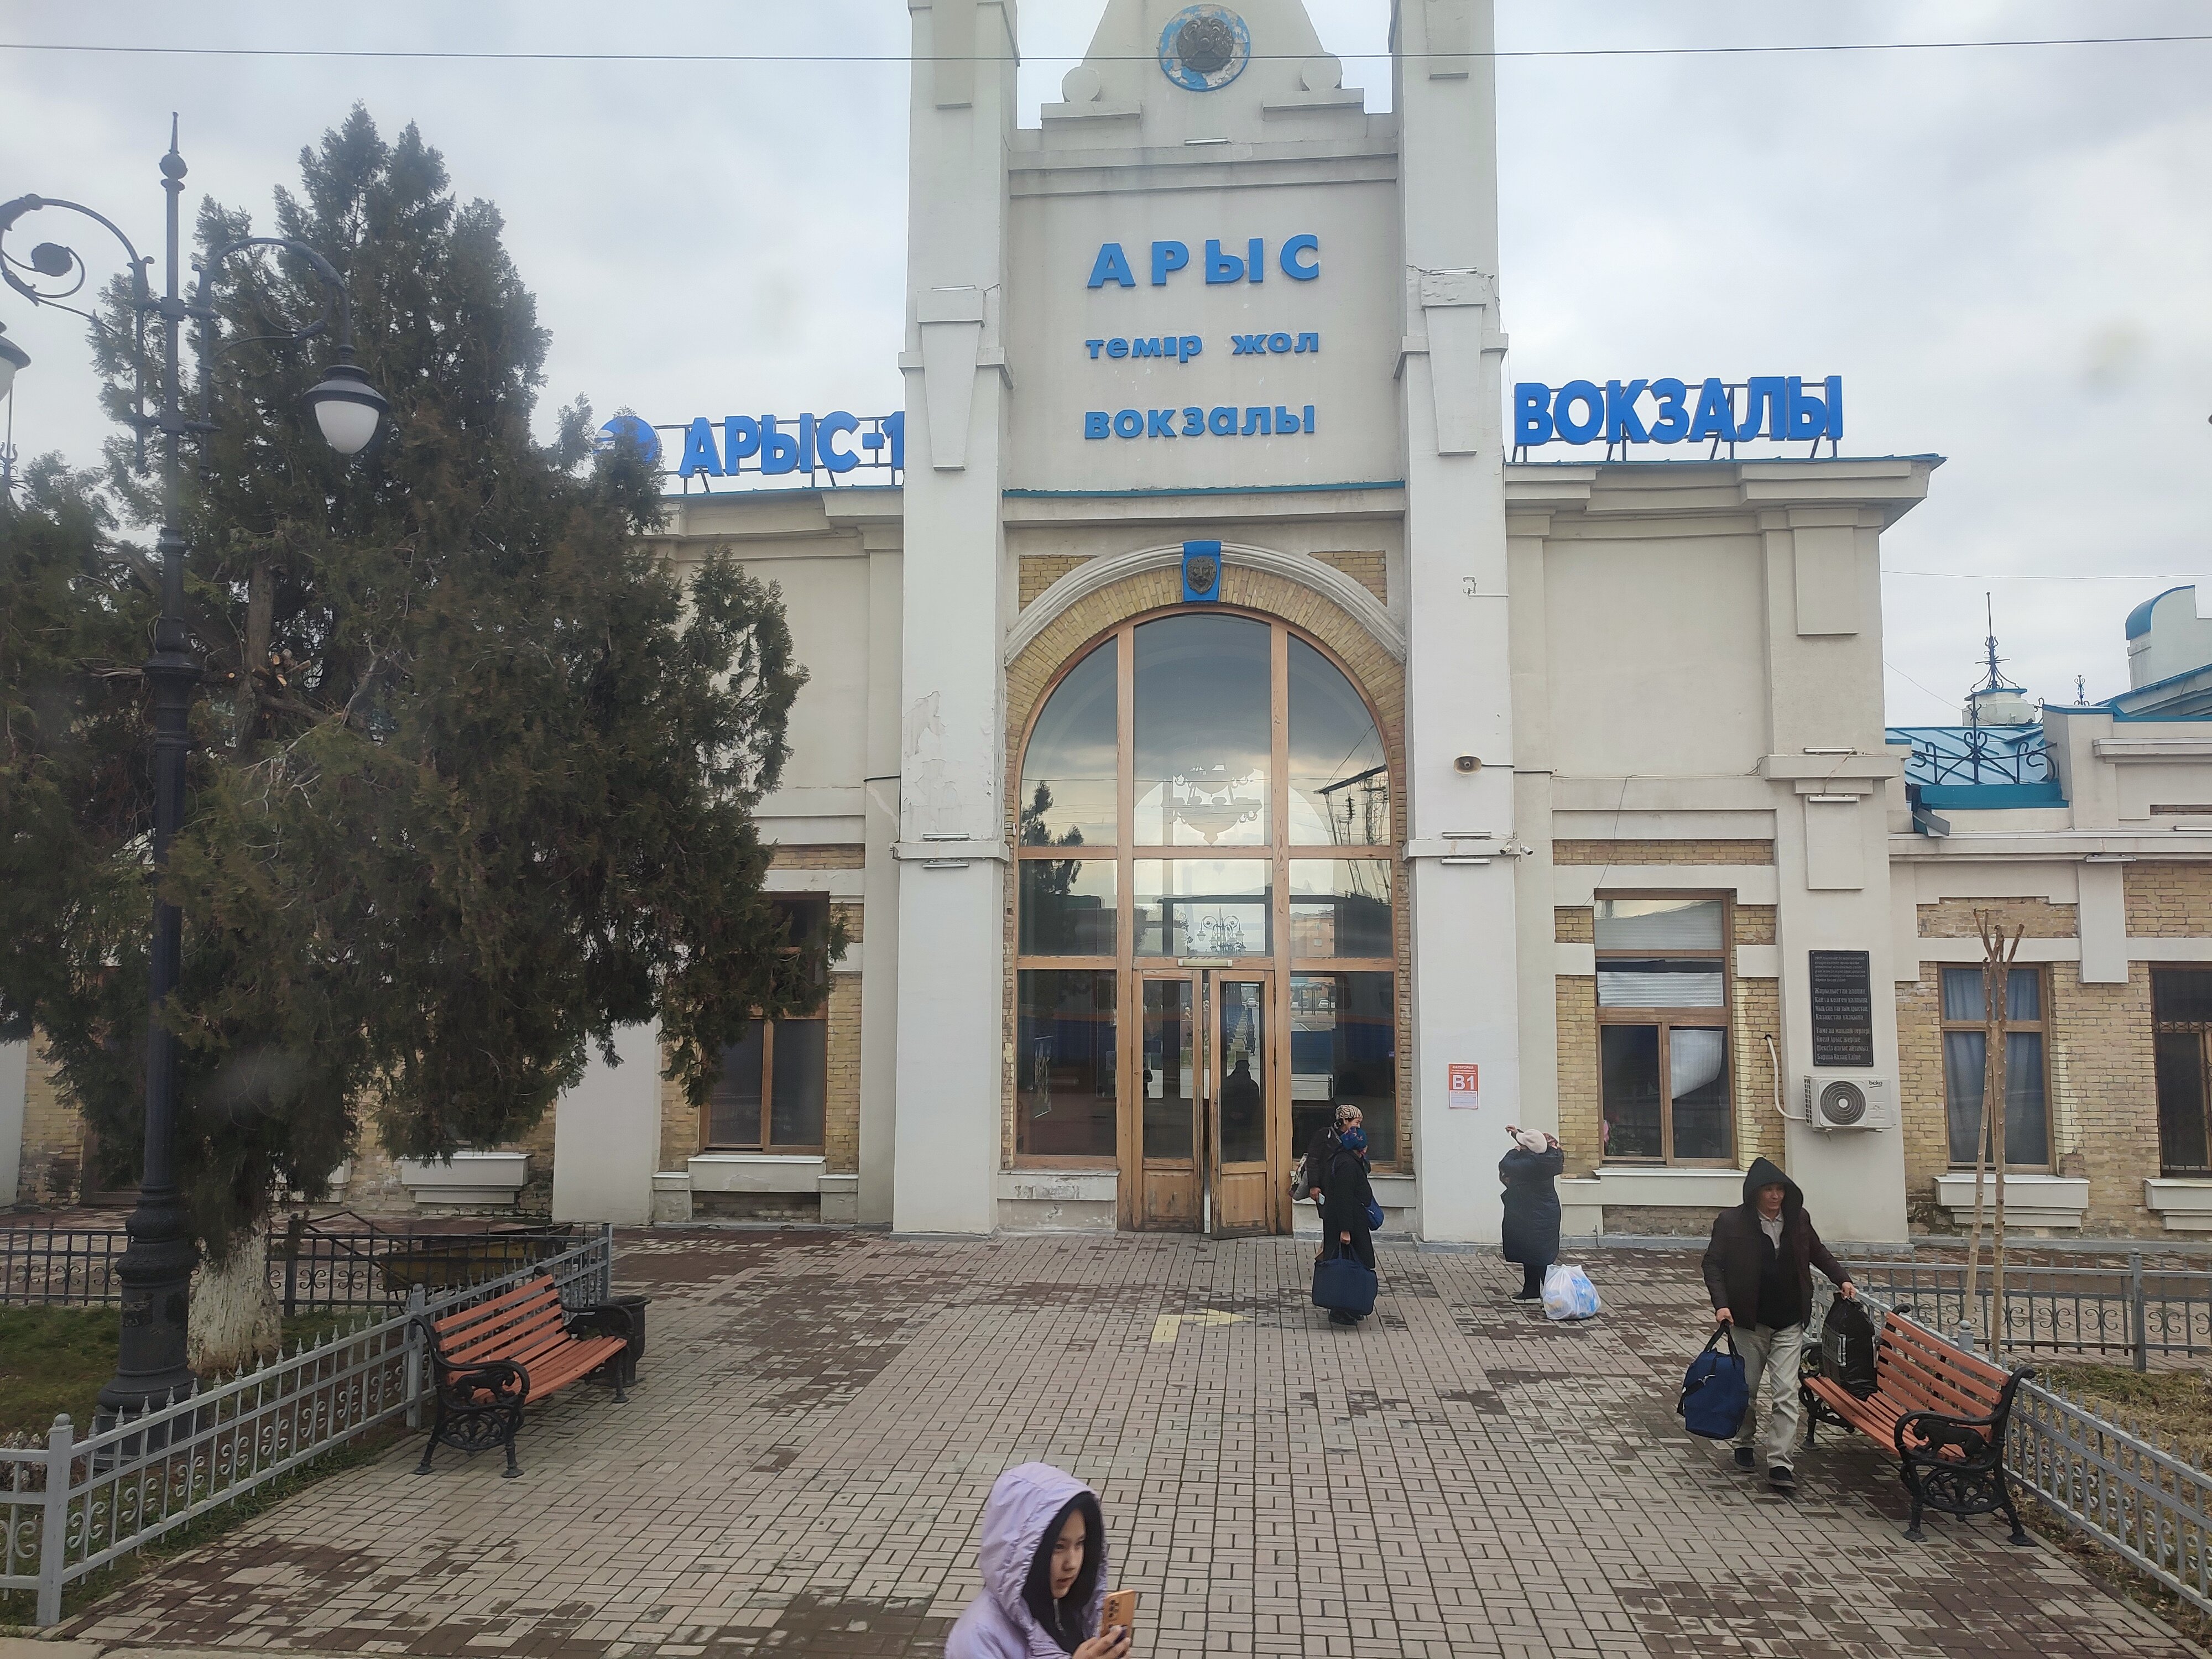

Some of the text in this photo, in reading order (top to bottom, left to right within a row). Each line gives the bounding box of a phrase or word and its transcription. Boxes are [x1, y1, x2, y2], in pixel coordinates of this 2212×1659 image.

[1087, 233, 1319, 288] АРЫС
[1086, 332, 1319, 363] темір жол
[679, 375, 1842, 478] АРЫС-1 ВОКЗАЛЫ
[1084, 405, 1314, 440] вокзалы
